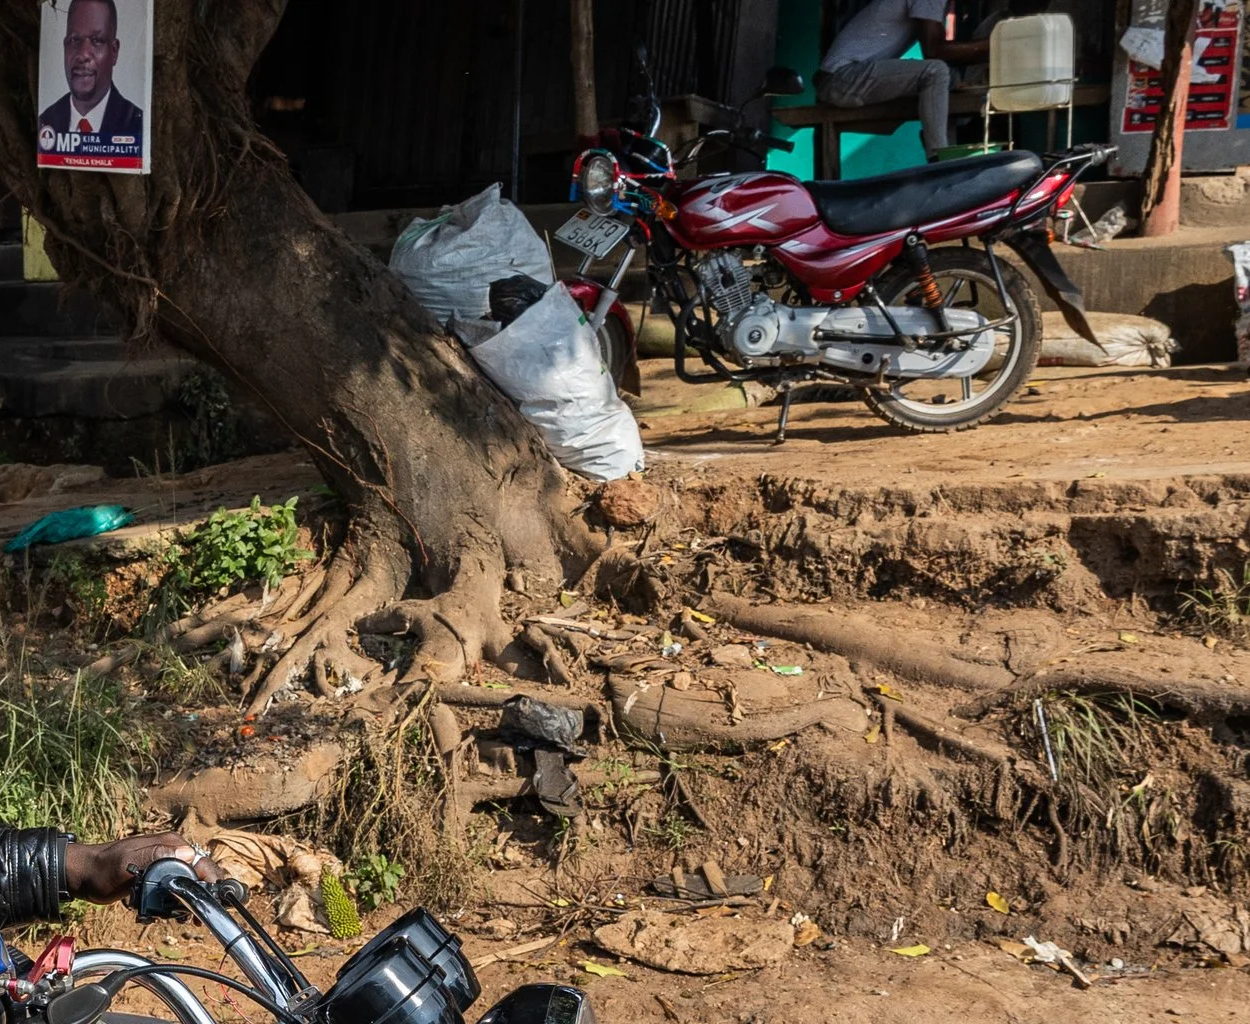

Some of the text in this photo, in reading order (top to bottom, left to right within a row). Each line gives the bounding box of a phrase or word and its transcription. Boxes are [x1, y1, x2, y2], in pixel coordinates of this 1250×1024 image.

[56, 132, 81, 153] MP
[82, 145, 140, 154] MUNICIPALITY
[83, 135, 101, 144] KIRA
[588, 216, 619, 238] UFQ
[567, 227, 605, 253] 586K
